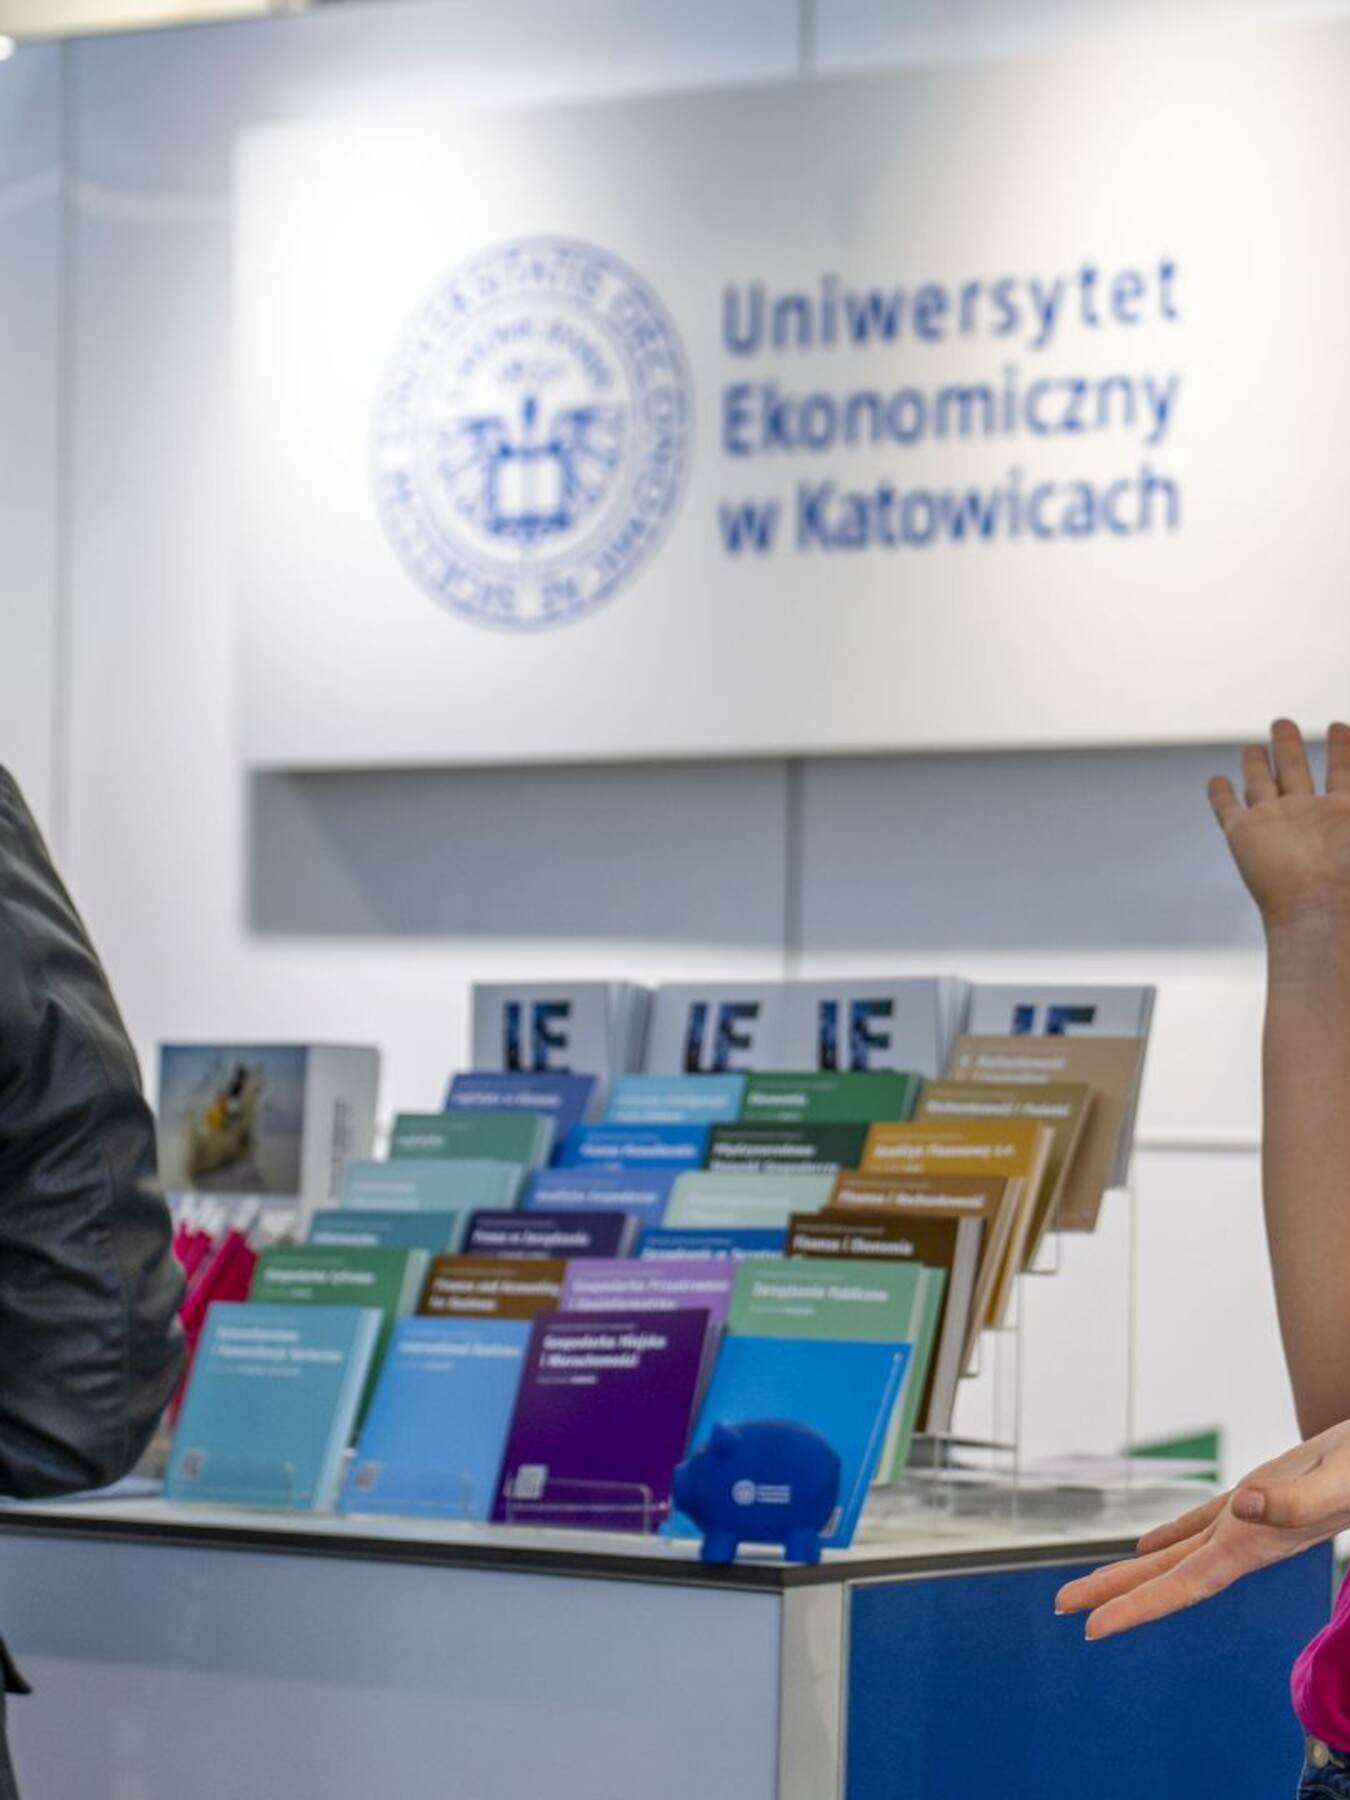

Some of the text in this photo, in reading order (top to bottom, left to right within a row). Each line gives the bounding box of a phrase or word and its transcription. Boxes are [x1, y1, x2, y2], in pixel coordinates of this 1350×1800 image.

[720, 257, 1183, 356] Uniwersytet
[720, 365, 1183, 458] Ekonomiczny
[718, 464, 1183, 559] w Katowicach
[542, 1334, 616, 1351] Gospodarka
